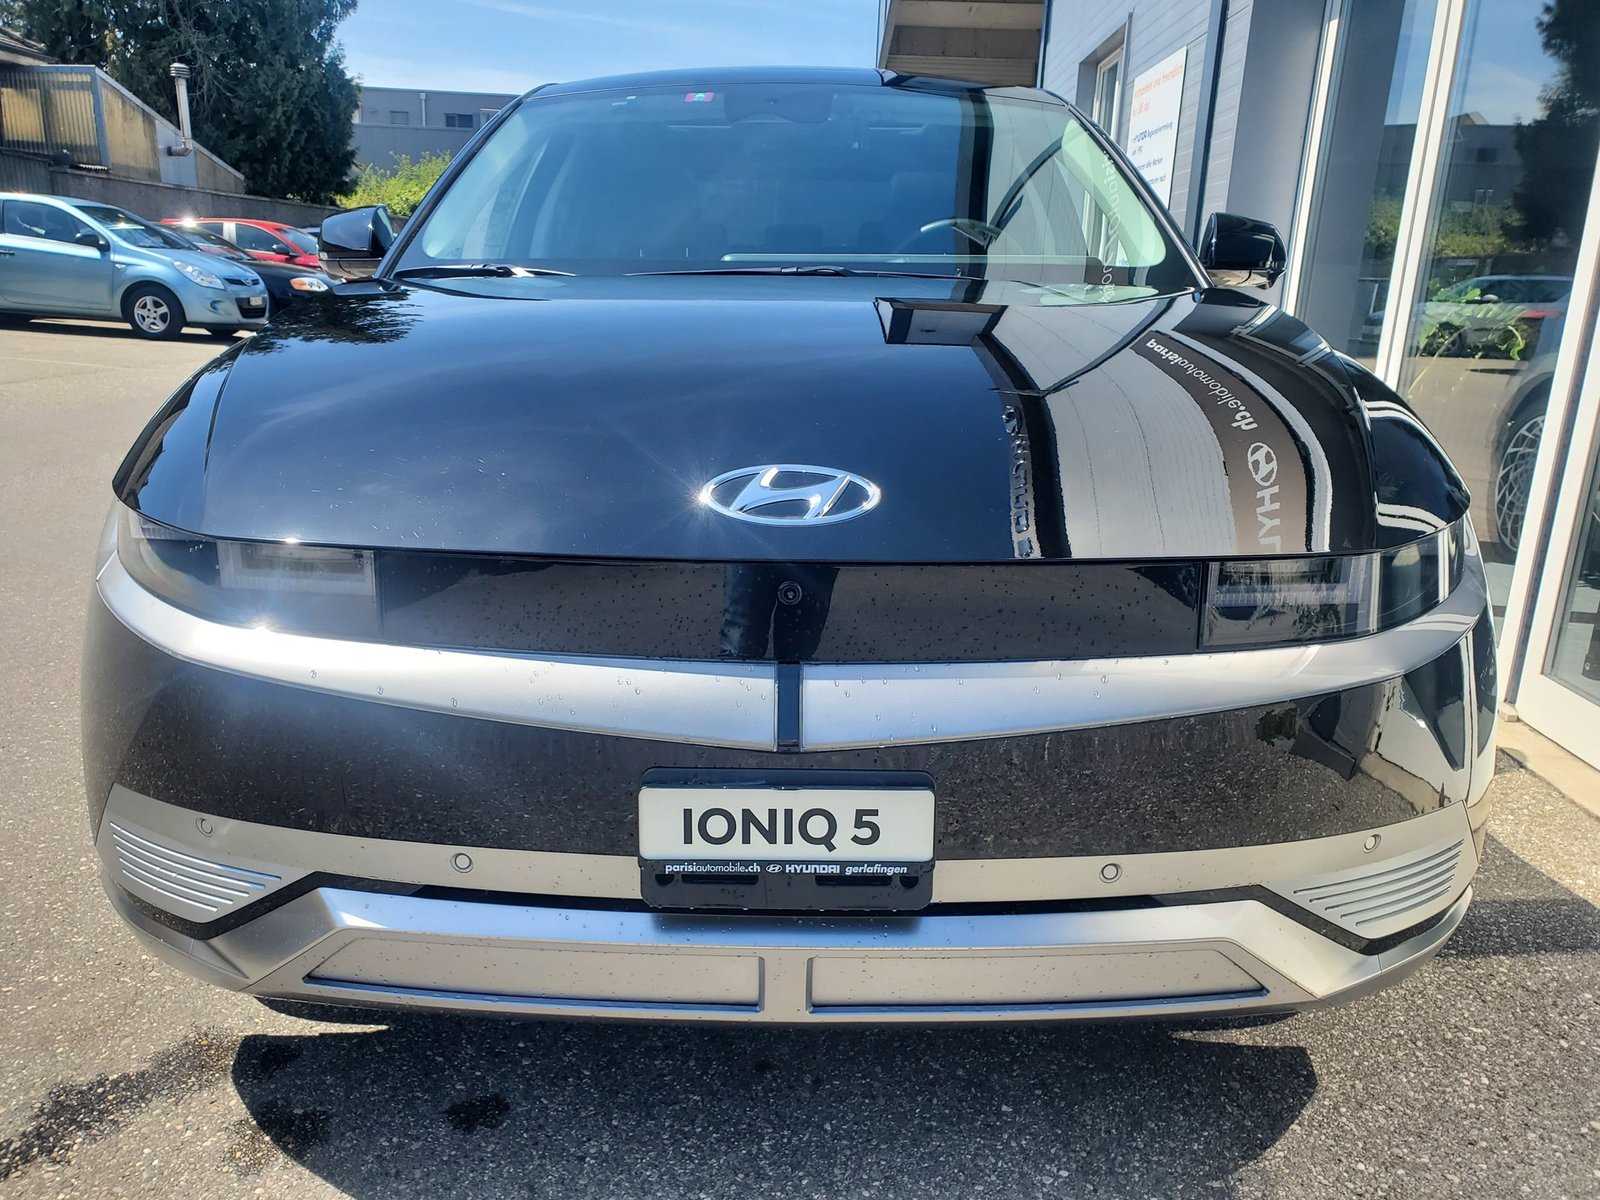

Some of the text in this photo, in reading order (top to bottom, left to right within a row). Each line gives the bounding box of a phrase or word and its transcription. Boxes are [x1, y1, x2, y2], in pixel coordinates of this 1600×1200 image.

[683, 808, 881, 852] IONIQ 5
[665, 862, 908, 875] parisiautomobile.ch HYUNDAI gerlafingen
